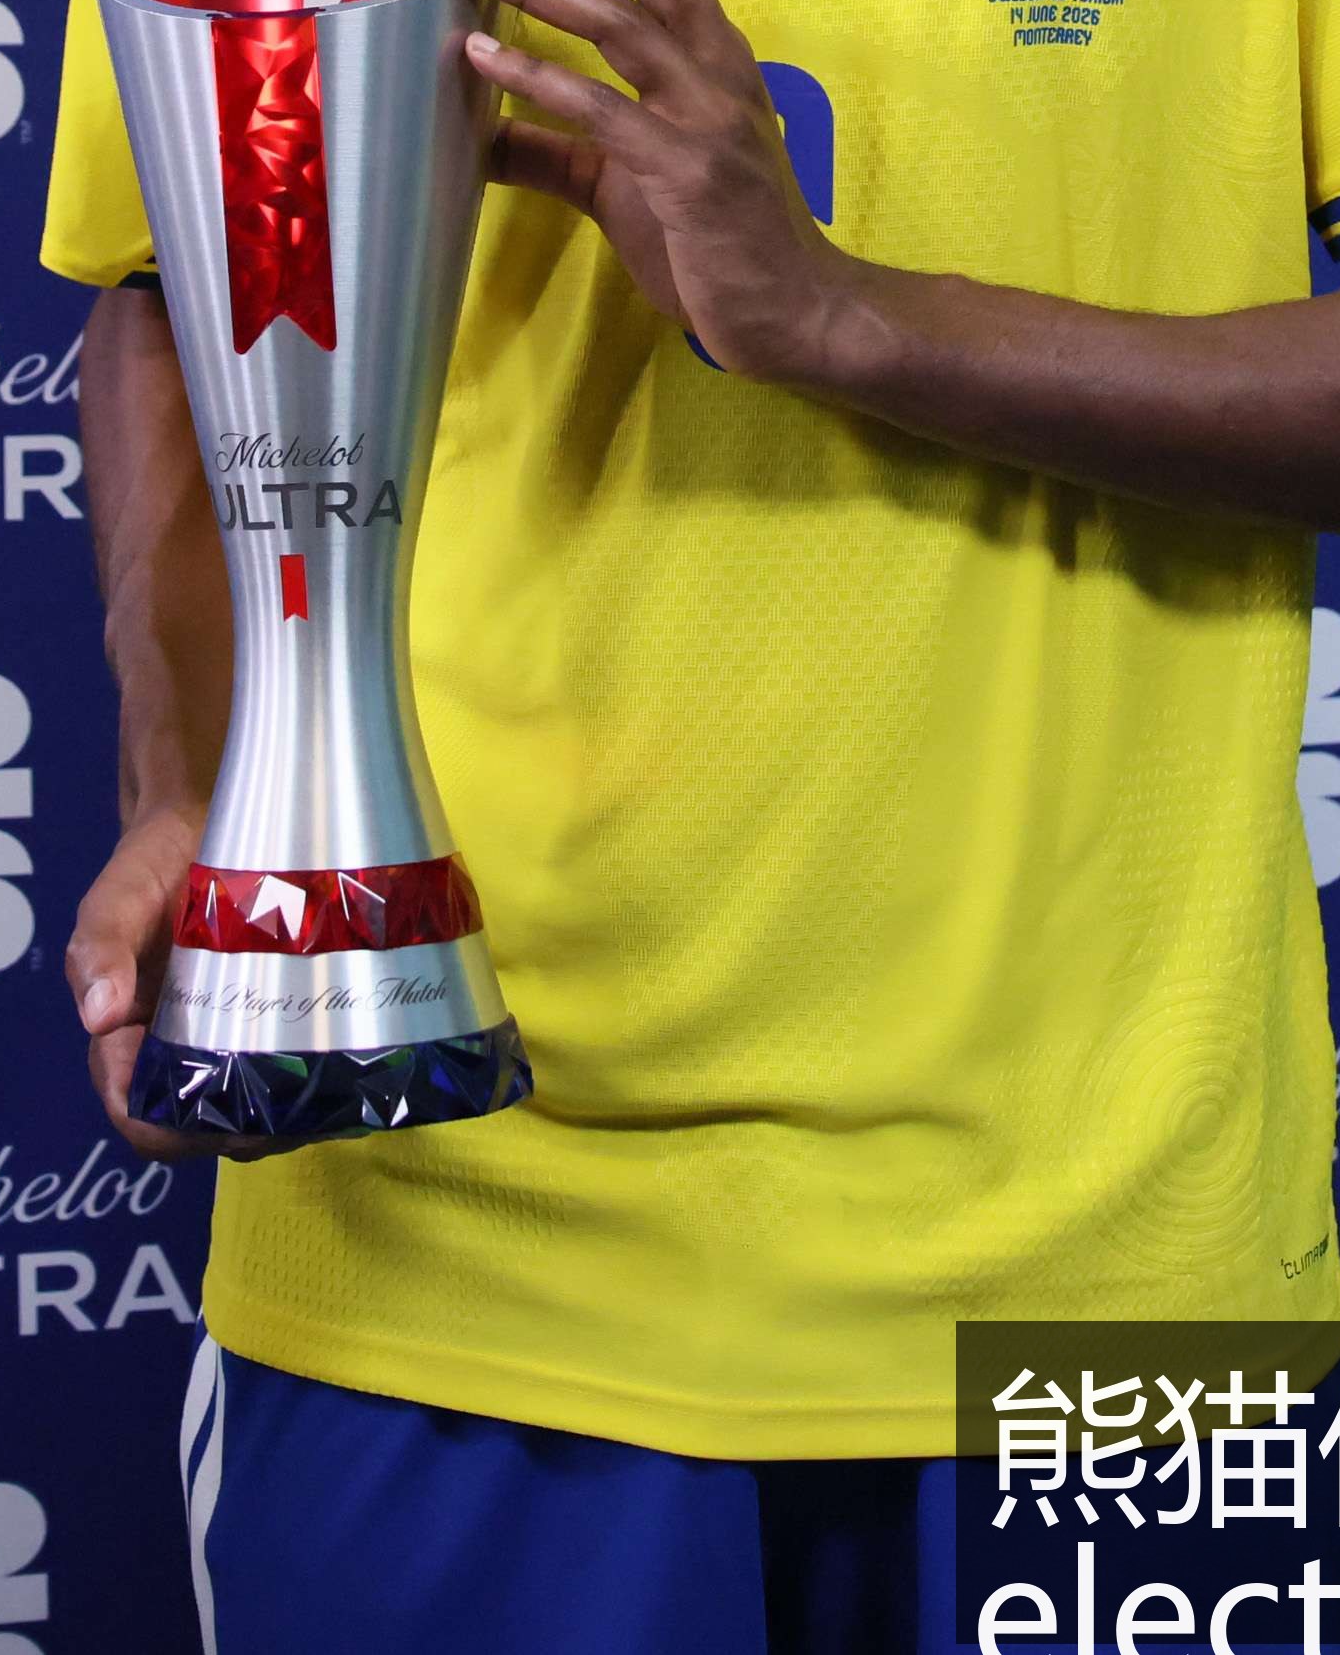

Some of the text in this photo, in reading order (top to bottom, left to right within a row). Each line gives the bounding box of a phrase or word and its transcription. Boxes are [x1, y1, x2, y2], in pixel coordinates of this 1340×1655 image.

[1010, 5, 1101, 26] 14 JUNE 2026
[1013, 26, 1093, 47] MONTERREY
[215, 432, 366, 473] Michelob
[211, 479, 403, 531] ULTRA
[213, 982, 293, 1021] Player
[281, 985, 325, 1023] of
[324, 988, 359, 1011] the
[366, 976, 448, 1011] Match
